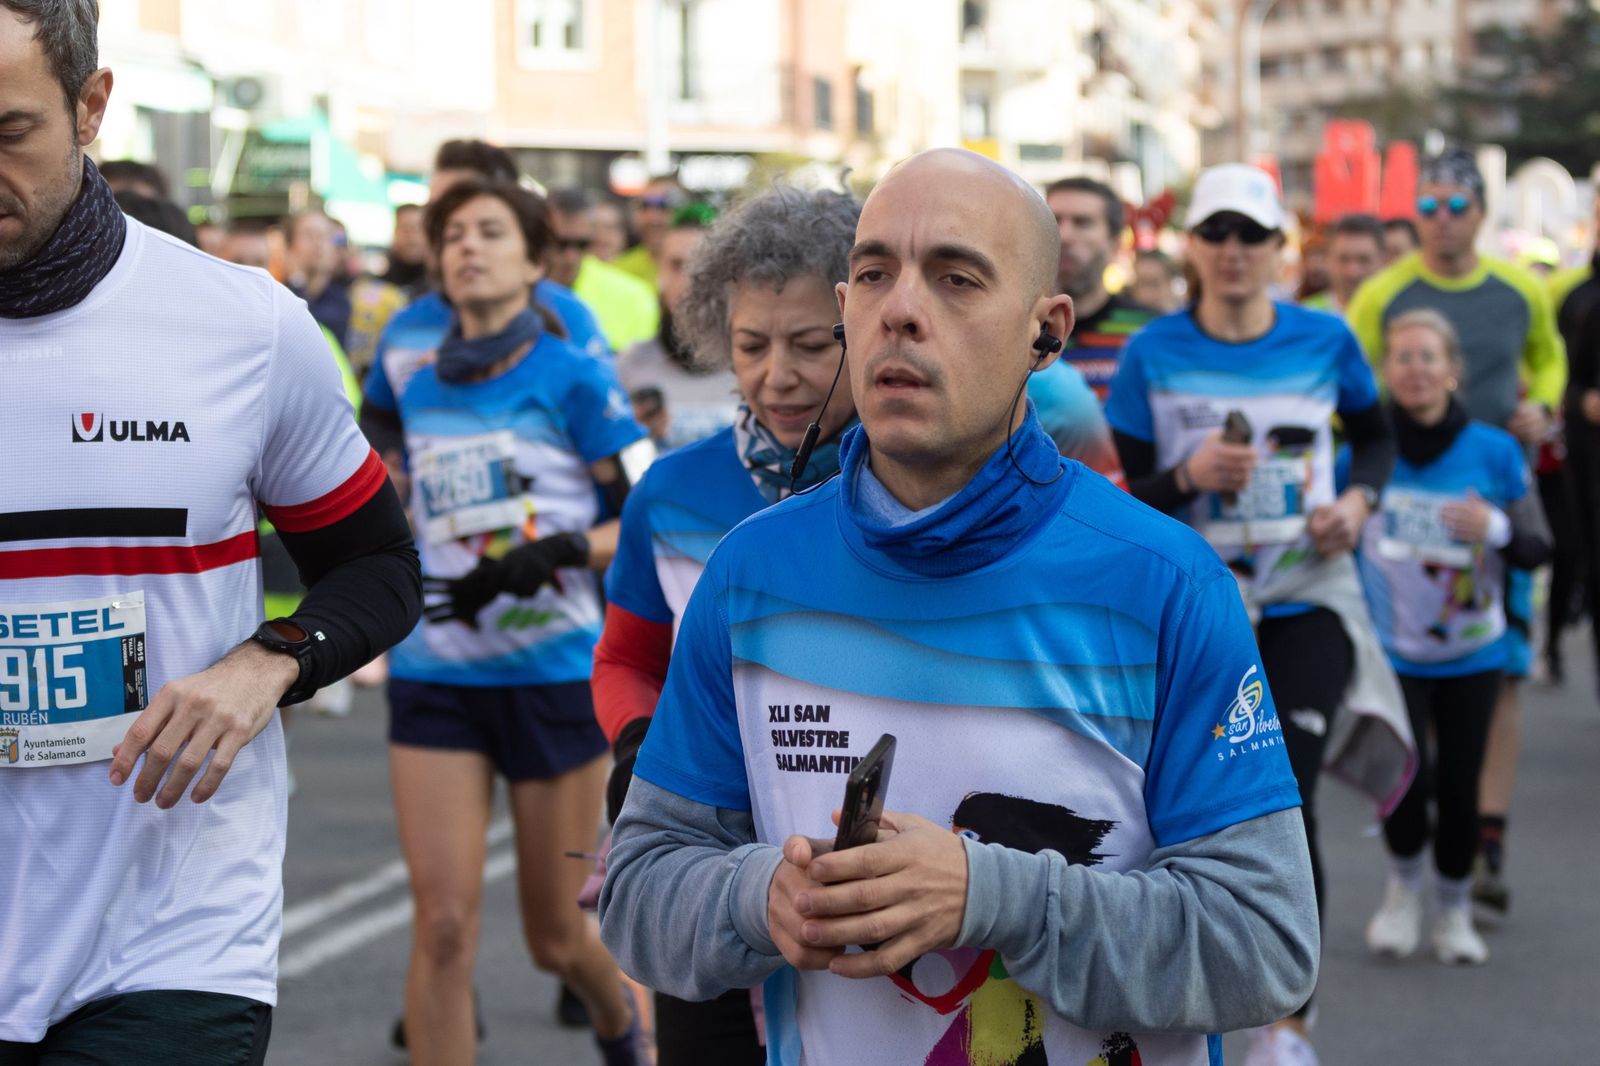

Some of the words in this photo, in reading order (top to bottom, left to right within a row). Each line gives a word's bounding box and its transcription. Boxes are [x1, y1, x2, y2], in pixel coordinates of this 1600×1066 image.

[109, 420, 191, 442] ULMA
[0, 644, 88, 711] 915
[3, 710, 49, 725] RUBÉN
[768, 705, 790, 723] XLI
[794, 704, 831, 723] SAN
[23, 736, 86, 751] Ayuntamiento
[771, 729, 850, 749] SILVESTRE
[24, 752, 36, 762] de
[37, 750, 87, 761] Salamanca
